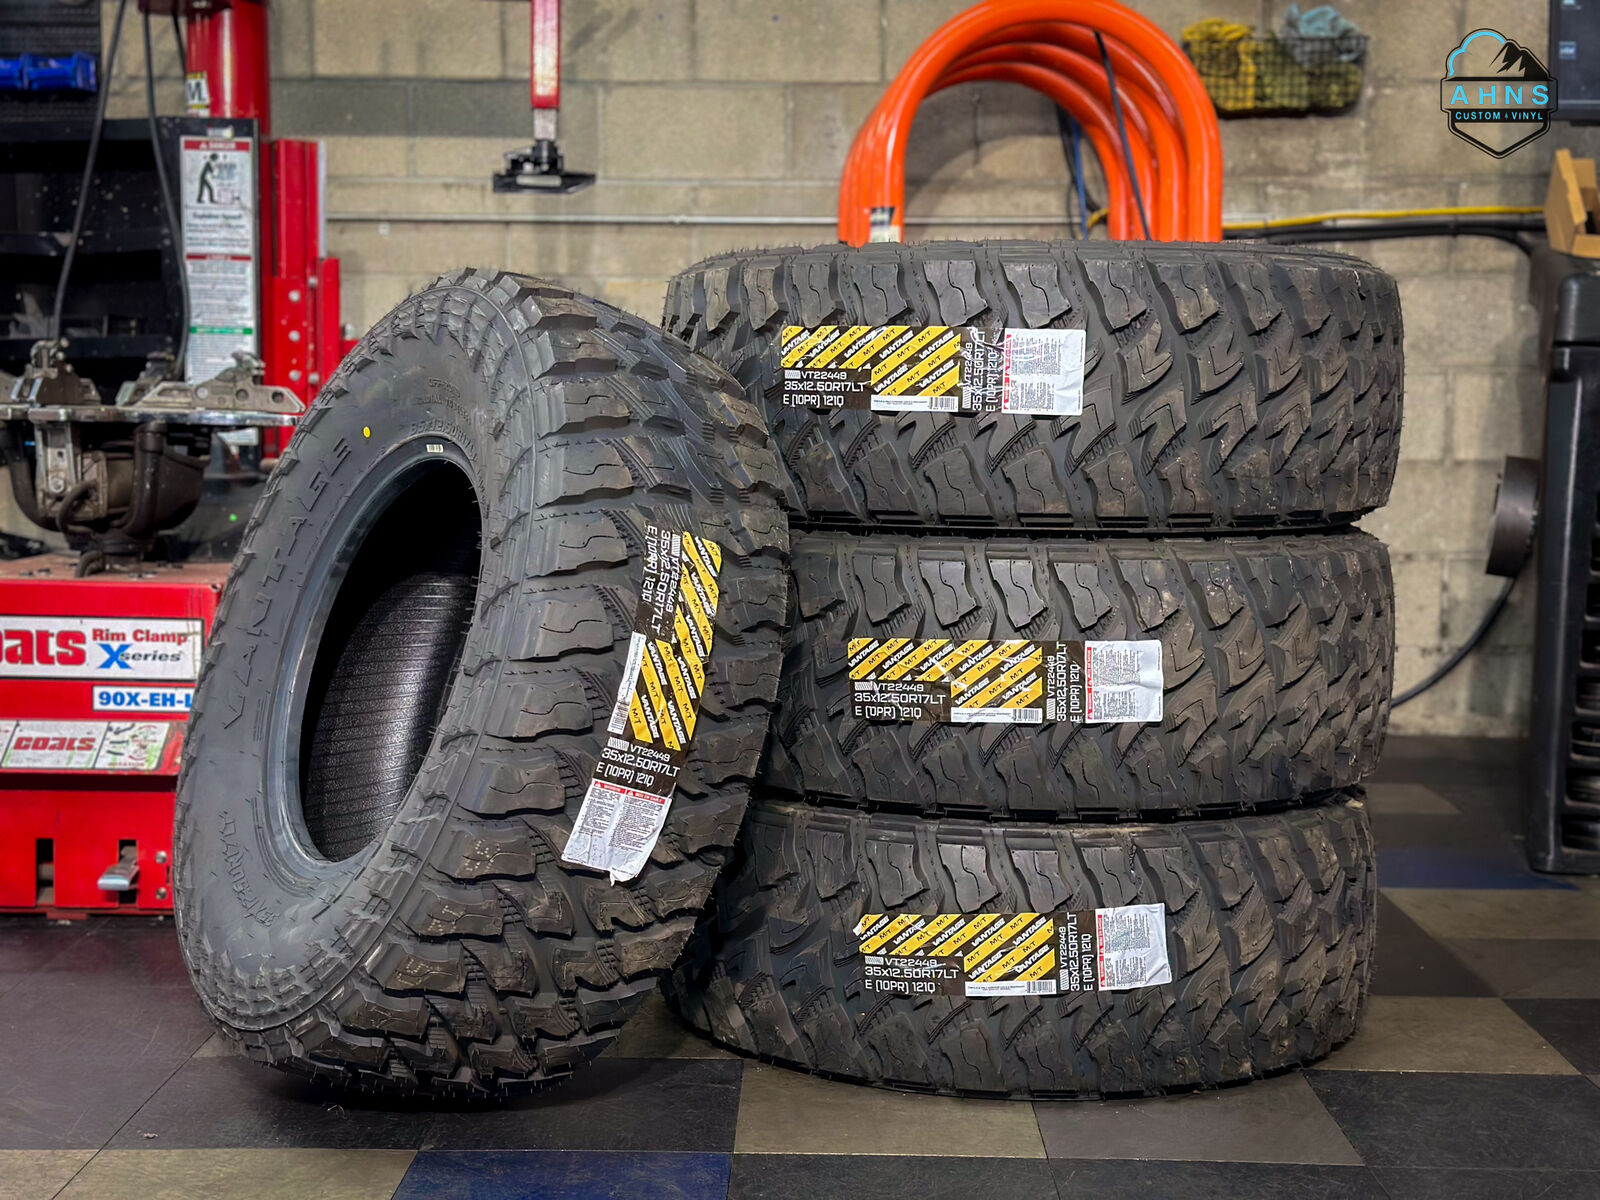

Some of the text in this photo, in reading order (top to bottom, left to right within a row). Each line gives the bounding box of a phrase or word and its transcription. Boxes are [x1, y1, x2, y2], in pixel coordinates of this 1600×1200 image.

[849, 327, 861, 338] M/T
[882, 329, 895, 340] M/T
[918, 330, 931, 343] M/T
[798, 342, 810, 354] M/T
[830, 342, 842, 354] M/T
[863, 345, 875, 356] M/T
[879, 330, 914, 359] VANTAGE
[919, 330, 954, 359] VANTAGE
[897, 346, 910, 358] M/T
[928, 355, 941, 368] M/T
[801, 371, 847, 380] VT22449
[874, 364, 888, 376] M/T
[907, 370, 920, 382] M/T
[920, 360, 954, 388] VANTAGE
[874, 364, 908, 392] VANTAGE
[784, 381, 865, 392] 35x12.50R17LT
[932, 382, 946, 394] M/T
[783, 394, 790, 405] E
[823, 395, 844, 408] 121Q
[648, 526, 658, 535] E
[708, 543, 719, 556] M/T
[642, 576, 656, 602] 121Q
[708, 584, 718, 599] M/T
[692, 598, 700, 614] M/T
[92, 628, 188, 646] Rim Clamp
[686, 614, 706, 657] VANTAGE
[702, 626, 712, 641] M/T
[0, 630, 86, 666] ats
[684, 638, 692, 654] M/T
[886, 640, 899, 650] M/T
[924, 640, 937, 652] M/T
[962, 643, 975, 654] M/T
[998, 644, 1012, 656] M/T
[98, 643, 182, 670] X series
[664, 646, 672, 662] M/T
[848, 640, 879, 667] VANTAGE
[868, 654, 880, 664] M/T
[882, 642, 914, 670] VANTAGE
[904, 654, 918, 666] M/T
[920, 644, 954, 671] VANTAGE
[959, 644, 994, 672] VANTAGE
[648, 641, 668, 686] VANTAGE
[942, 658, 954, 668] M/T
[977, 660, 991, 672] M/T
[677, 656, 697, 700] VANTAGE
[694, 664, 702, 680] M/T
[1010, 668, 1024, 680] M/T
[1070, 664, 1080, 682] 121Q
[650, 682, 659, 698] M/T
[675, 676, 684, 692] M/T
[955, 678, 990, 704] VANTAGE
[988, 683, 1002, 695] M/T
[1002, 672, 1037, 700] VANTAGE
[1016, 694, 1030, 706] M/T
[632, 708, 641, 724] M/T
[682, 703, 692, 718] M/T
[855, 706, 862, 716] E
[668, 700, 686, 744] VANTAGE
[630, 744, 670, 762] VT22449
[602, 748, 680, 777] 35x12.50R17LT
[596, 762, 605, 772] E
[636, 772, 654, 787] 121Q
[936, 916, 948, 926] M/T
[974, 917, 986, 929] M/T
[1010, 917, 1024, 930] M/T
[880, 929, 892, 940] M/T
[916, 931, 929, 941] M/T
[932, 918, 966, 946] VANTAGE
[972, 918, 1006, 946] VANTAGE
[1012, 916, 1046, 945] VANTAGE
[954, 932, 966, 944] M/T
[990, 934, 1002, 945] M/T
[1082, 934, 1092, 952] 121Q
[1022, 940, 1036, 953] M/T
[1059, 927, 1067, 968] VT22449
[1067, 912, 1080, 991] 35x12.50R17LT
[885, 958, 937, 966] VT22449
[967, 950, 980, 963] M/T
[1002, 957, 1015, 968] M/T
[864, 966, 958, 978] 35x12.50R17LT
[968, 951, 1003, 980] VANTAGE
[1030, 966, 1042, 978] M/T
[865, 980, 872, 989] E
[912, 982, 936, 994] 121Q
